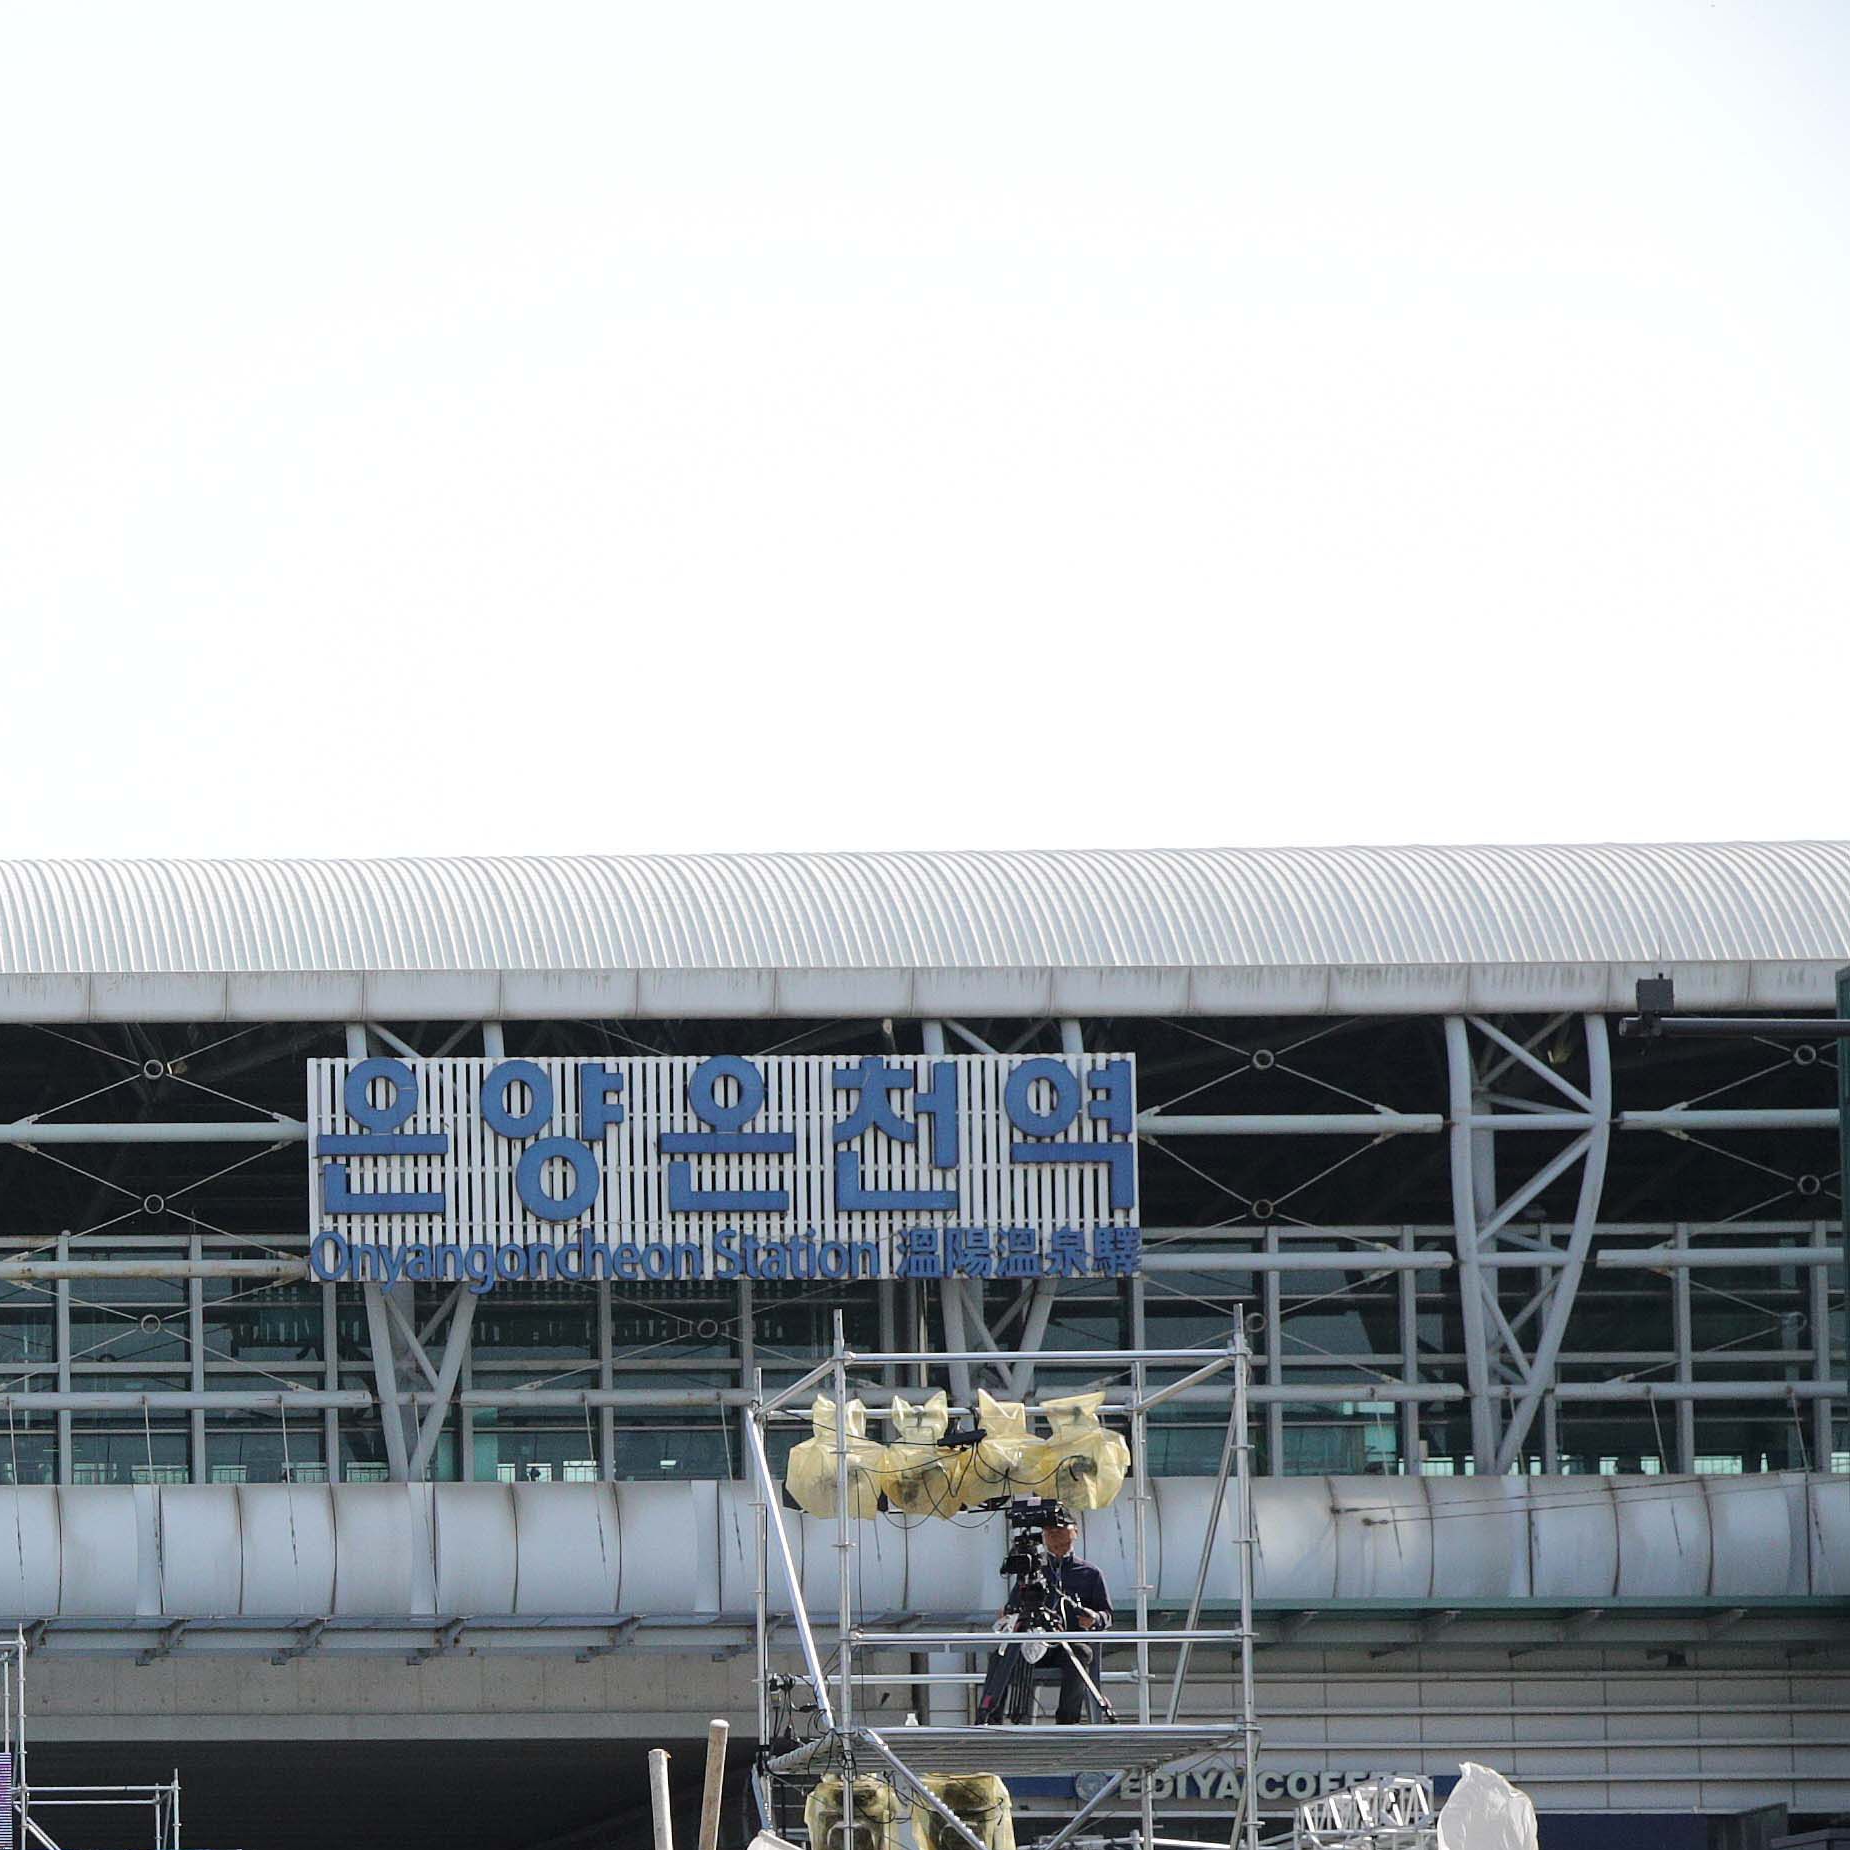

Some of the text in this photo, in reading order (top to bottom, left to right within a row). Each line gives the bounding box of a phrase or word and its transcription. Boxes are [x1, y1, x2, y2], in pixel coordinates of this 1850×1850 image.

[316, 1056, 1133, 1222] 온양온천역
[310, 1229, 704, 1294] Onyangoncheon
[713, 1228, 881, 1280] Station
[1119, 1771, 1245, 1800] EDIYA
